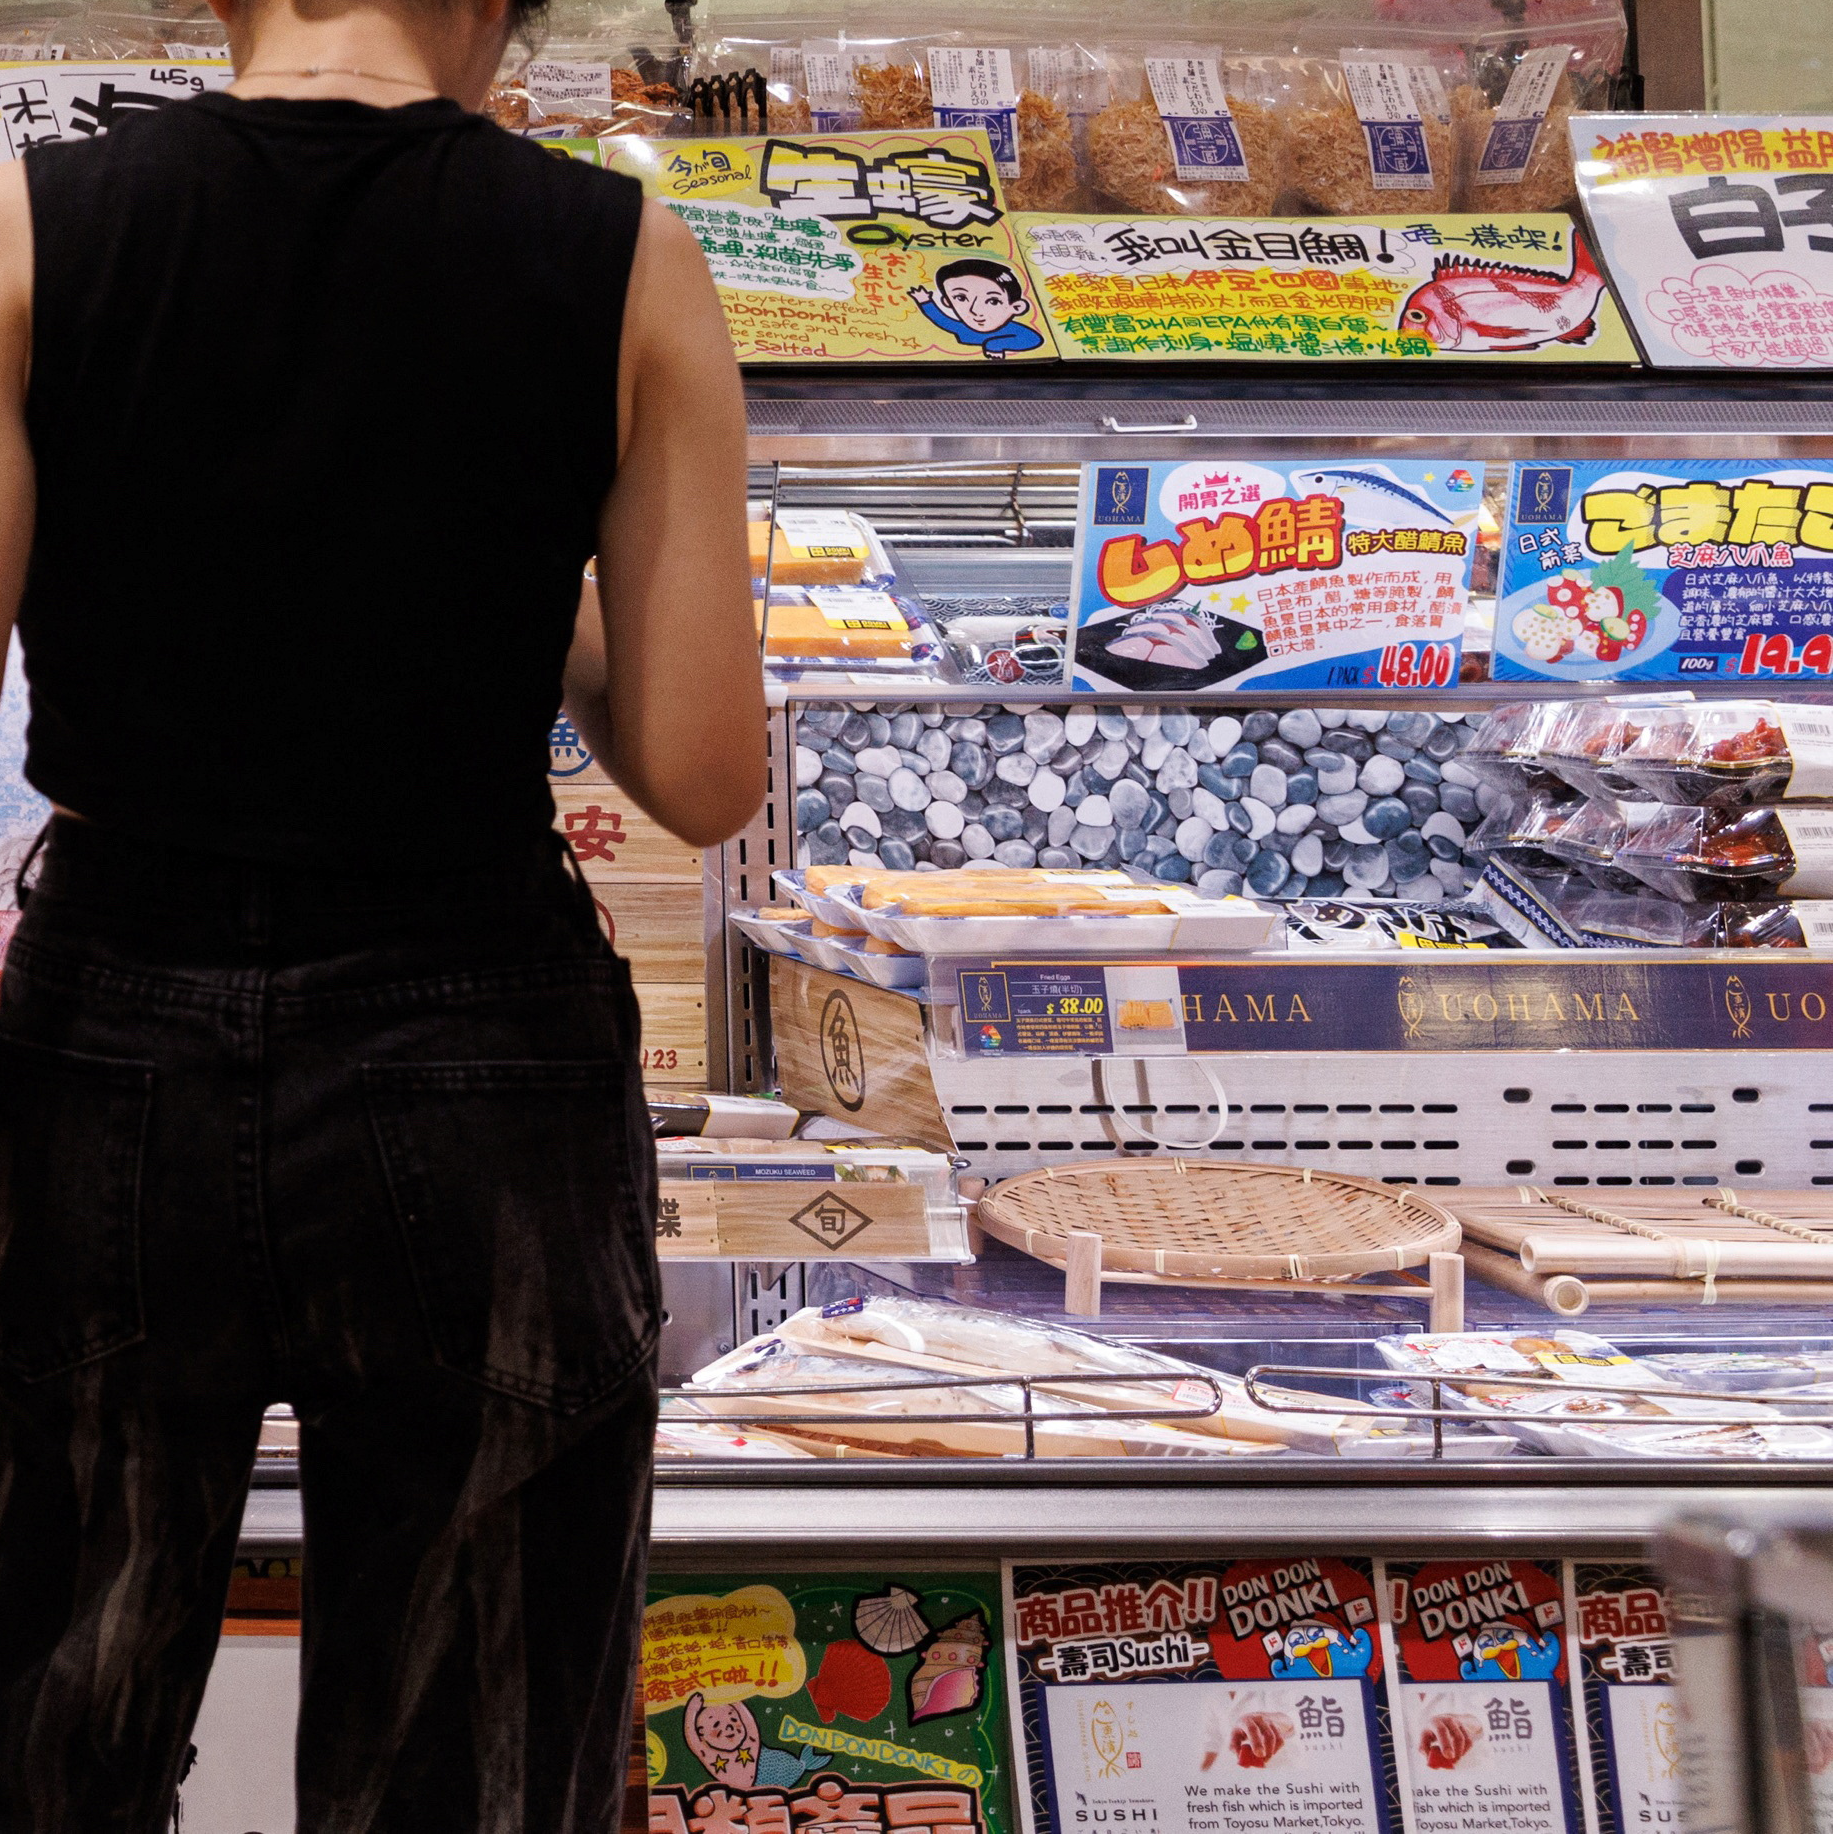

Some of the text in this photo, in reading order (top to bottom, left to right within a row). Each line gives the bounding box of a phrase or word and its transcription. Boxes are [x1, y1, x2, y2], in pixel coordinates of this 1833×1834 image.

[150, 68, 204, 92] 45g
[673, 166, 751, 195] Seasonal
[760, 138, 1005, 230] 生蠔
[847, 224, 993, 251] Oyster
[751, 328, 810, 342] served
[805, 323, 897, 344] and fresh
[755, 339, 827, 357] Salted
[1178, 484, 1261, 511] 開胃之選
[1098, 515, 1142, 523] UOHAMA
[1097, 493, 1344, 608] しめ鯖
[1347, 530, 1467, 556] 特大醋鯖魚
[1519, 527, 1563, 554] 日式
[1539, 543, 1583, 570] 前菜
[1668, 543, 1794, 567] 芝麻八爪魚
[1335, 642, 1451, 688] PACK $ 48.00
[1681, 658, 1715, 670] 100g
[1057, 974, 1071, 982] Eggs
[1059, 998, 1104, 1014] 38.00
[1439, 992, 1640, 1022] UOHAMA
[827, 1002, 860, 1089] 魚
[755, 1168, 815, 1176] MOZUKU SEAWEED
[814, 1204, 845, 1234] 旬
[1223, 1578, 1269, 1608] DON
[1413, 1580, 1460, 1610] DON
[1016, 1578, 1216, 1642] 商品推介!!
[1228, 1579, 1341, 1638] DONKI
[1420, 1582, 1531, 1639] DONKI
[1295, 1696, 1345, 1740] 鮨
[1484, 1698, 1533, 1741] 鮨
[1075, 1809, 1158, 1822] SUSHI
